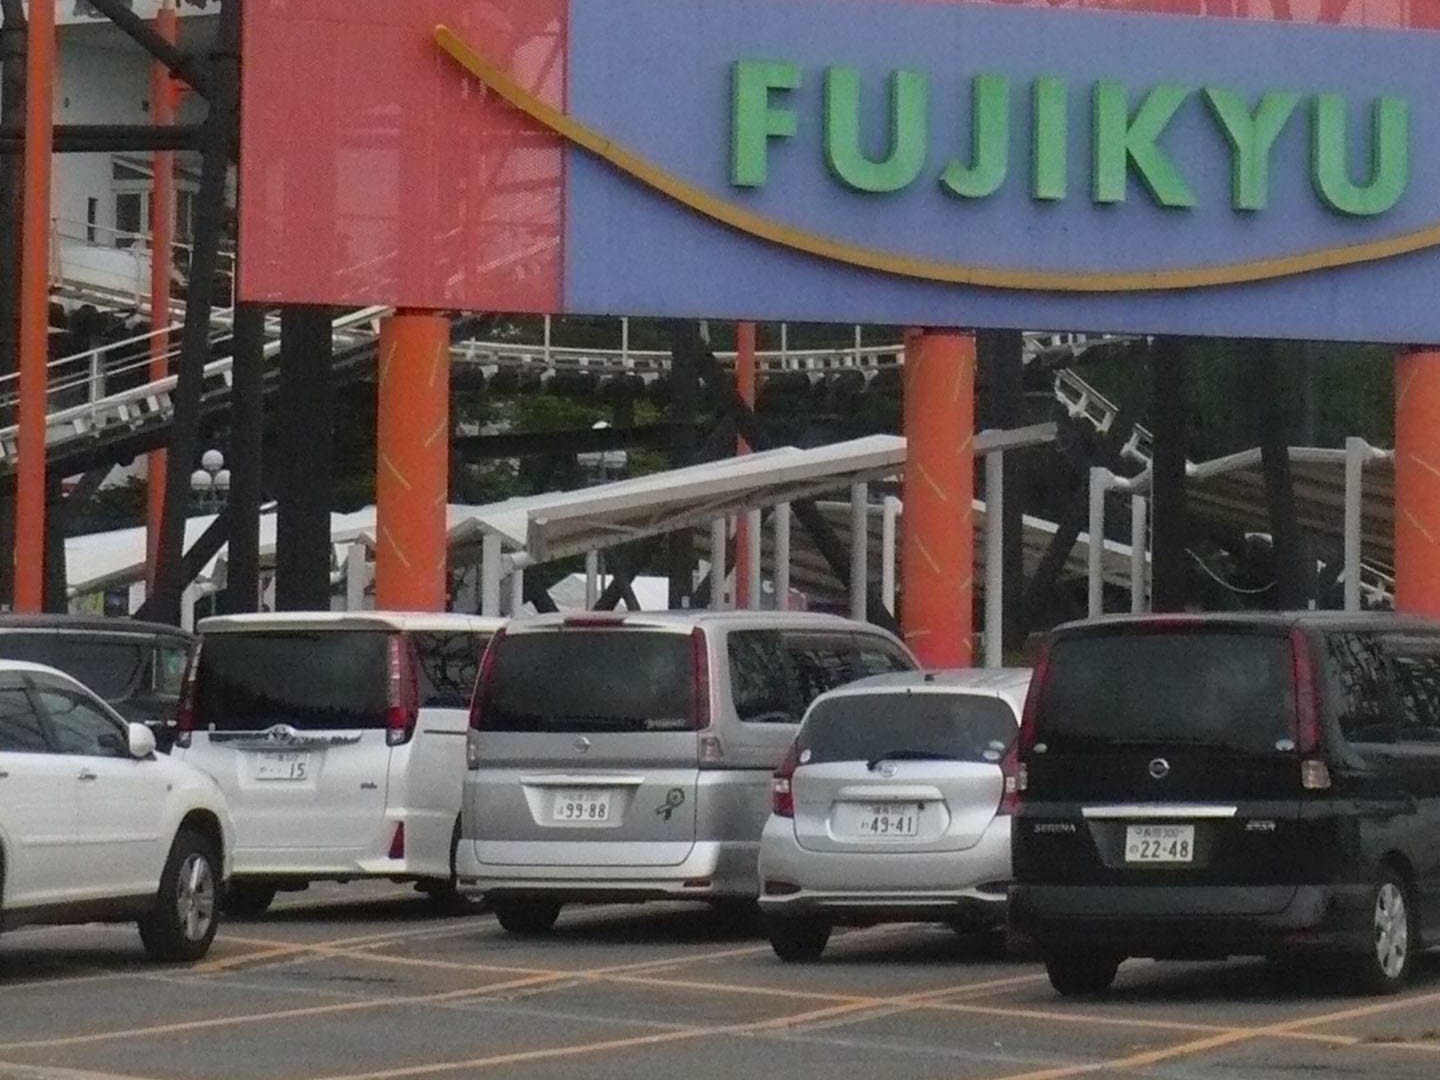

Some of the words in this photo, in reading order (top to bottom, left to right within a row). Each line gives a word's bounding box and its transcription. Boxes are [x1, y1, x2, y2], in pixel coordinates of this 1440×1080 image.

[731, 58, 1411, 216] FUJIKYU
[565, 802, 606, 819] 99-88
[870, 816, 912, 833] 49-41
[1140, 840, 1189, 858] 22-48
